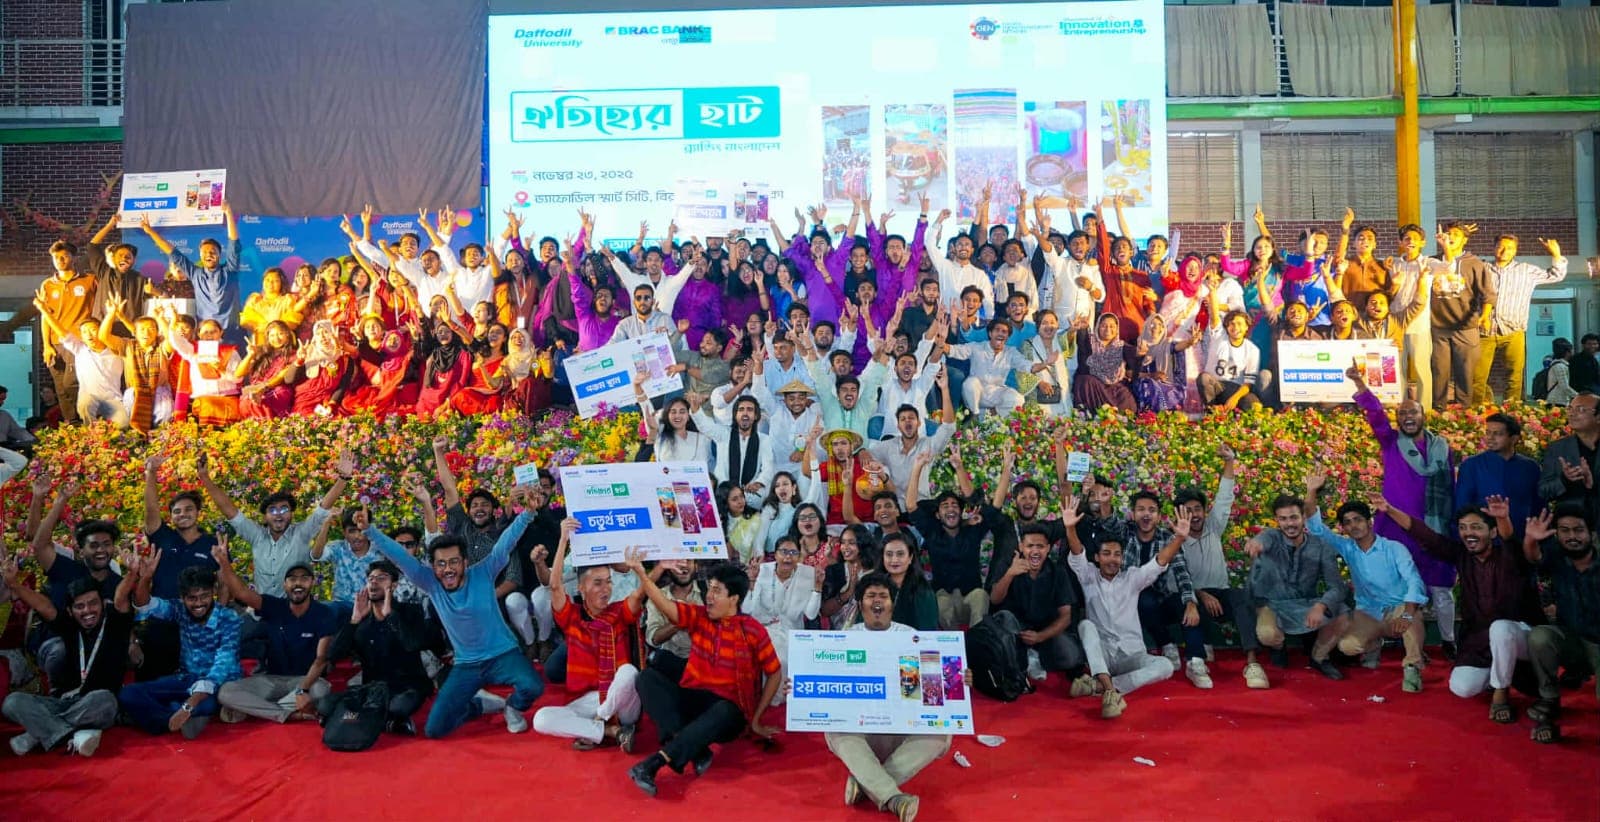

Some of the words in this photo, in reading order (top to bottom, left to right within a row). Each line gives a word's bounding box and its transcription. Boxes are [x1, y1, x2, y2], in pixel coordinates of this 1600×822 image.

[618, 26, 659, 35] BRAC
[661, 25, 704, 35] BANK
[1059, 20, 1131, 29] Innovation
[514, 28, 573, 39] Daffodil
[1063, 28, 1147, 36] Entrepreneurship
[523, 39, 583, 48] University
[521, 95, 673, 135] ঐতিহ্যের
[697, 95, 765, 128] হাট
[532, 170, 574, 181] নভেম্বর
[599, 169, 634, 180] ২০২৫
[534, 192, 595, 204] ড্যাফোডিল
[255, 238, 289, 246] Daffodil
[587, 511, 614, 531] চতুর্থ
[615, 513, 637, 528] স্থান
[796, 681, 814, 695] ২য়
[816, 681, 853, 696] রানার
[855, 682, 885, 696] আপ
